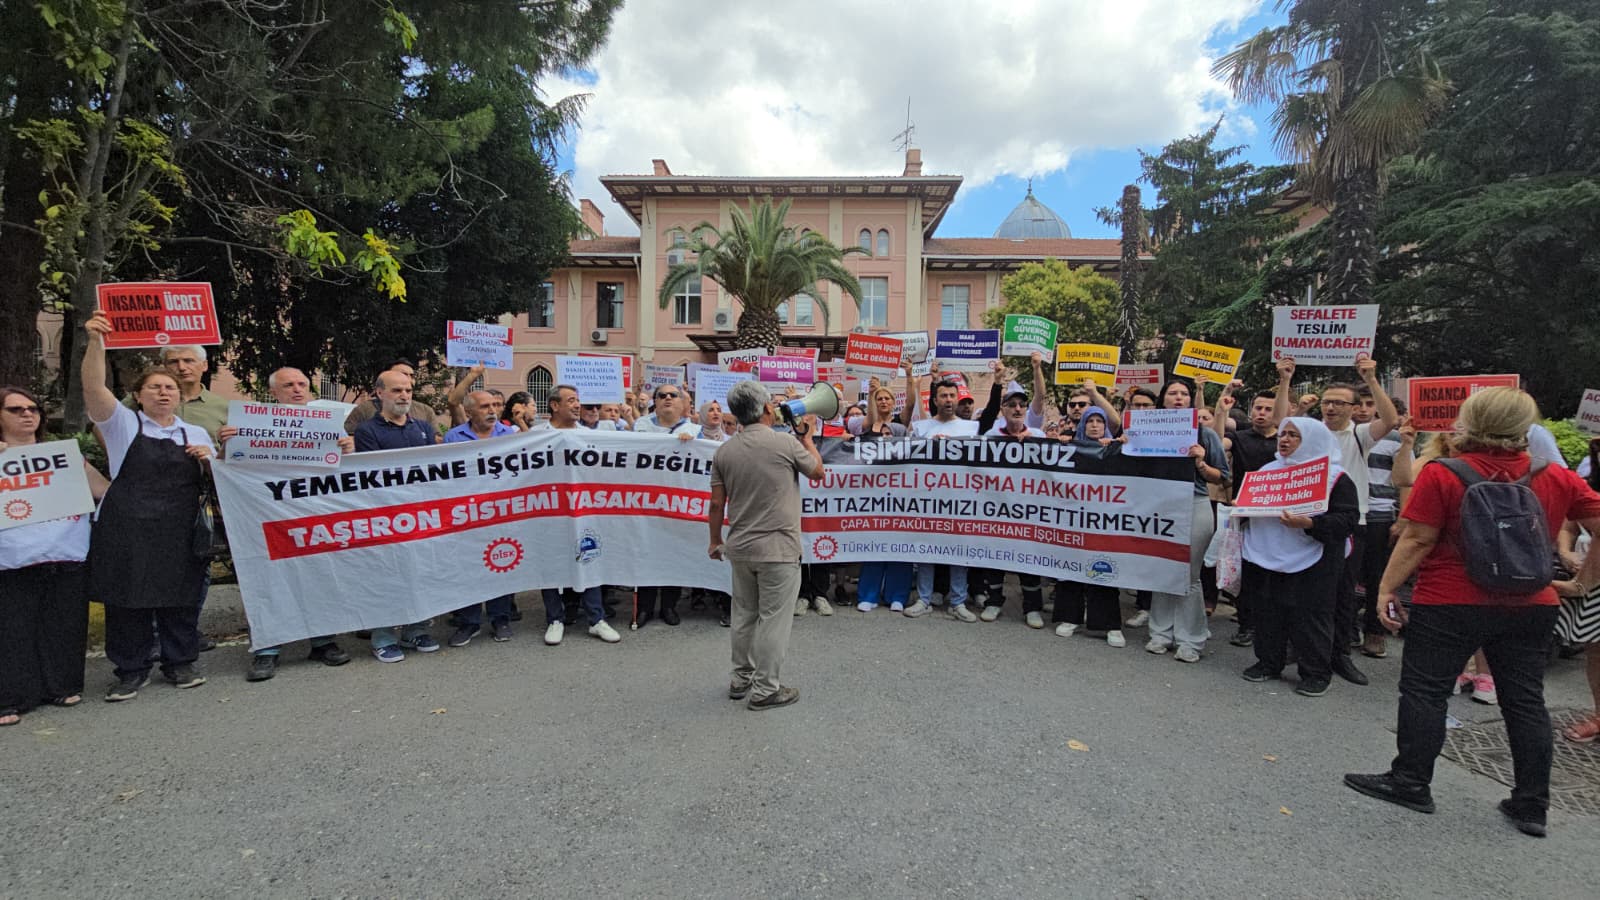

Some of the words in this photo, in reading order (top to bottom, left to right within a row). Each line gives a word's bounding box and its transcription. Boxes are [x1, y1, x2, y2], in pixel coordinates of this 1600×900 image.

[108, 292, 162, 311] İNSANCA
[164, 291, 202, 310] ÜCRET
[112, 313, 161, 332] VERGİDE
[164, 314, 206, 331] ADALET
[1290, 308, 1357, 320] SEFALETE
[1296, 321, 1347, 334] TESLİM
[1274, 336, 1371, 349] OLMAYACAĞIZ!
[1420, 385, 1467, 402] İNSANCA
[1585, 392, 1600, 404] AÇ
[243, 404, 268, 415] TÜM
[272, 406, 332, 419] ÜCRETLERE
[272, 418, 286, 428] EN
[290, 420, 304, 428] AZ
[238, 428, 276, 440] ERÇEK
[279, 429, 340, 440] ENFLASYON
[250, 440, 288, 448] KADAR
[939, 437, 1077, 468] İSTİYORUZ
[0, 453, 69, 477] GİDE
[264, 459, 467, 500] YEMEKHANE
[477, 445, 554, 479] İŞÇİSİ
[564, 445, 628, 468] KÖLE
[1248, 472, 1288, 482] Herkese
[1290, 462, 1326, 479] parasız
[924, 472, 1014, 494] ÇALIŞMA
[1021, 478, 1127, 504] HAKKIMIZ
[1248, 483, 1267, 495] eşit
[1270, 484, 1282, 492] ve
[1284, 474, 1321, 490] nitelikli
[1251, 494, 1283, 504] sağlık
[1285, 490, 1312, 501] hakkı
[288, 508, 442, 548] TAŞERON
[450, 486, 560, 525] SİSTEMİ
[566, 490, 710, 516] YASAKLANSI
[802, 498, 828, 513] EM
[833, 493, 977, 516] TAZMİNATIMIZI
[983, 501, 1175, 538] GASPETTİRMEYİZ
[840, 519, 870, 531] ÇAPA
[872, 518, 890, 529] TIP
[892, 518, 954, 532] FAKÜLTESİ
[956, 521, 1031, 538] YEMEKHANE
[1033, 526, 1084, 546] İŞÇİLERİ
[492, 550, 515, 560] DİSK
[842, 540, 888, 553] TÜRKİYE
[890, 543, 917, 554] GIDA
[1016, 552, 1082, 572] SENDİKASI
